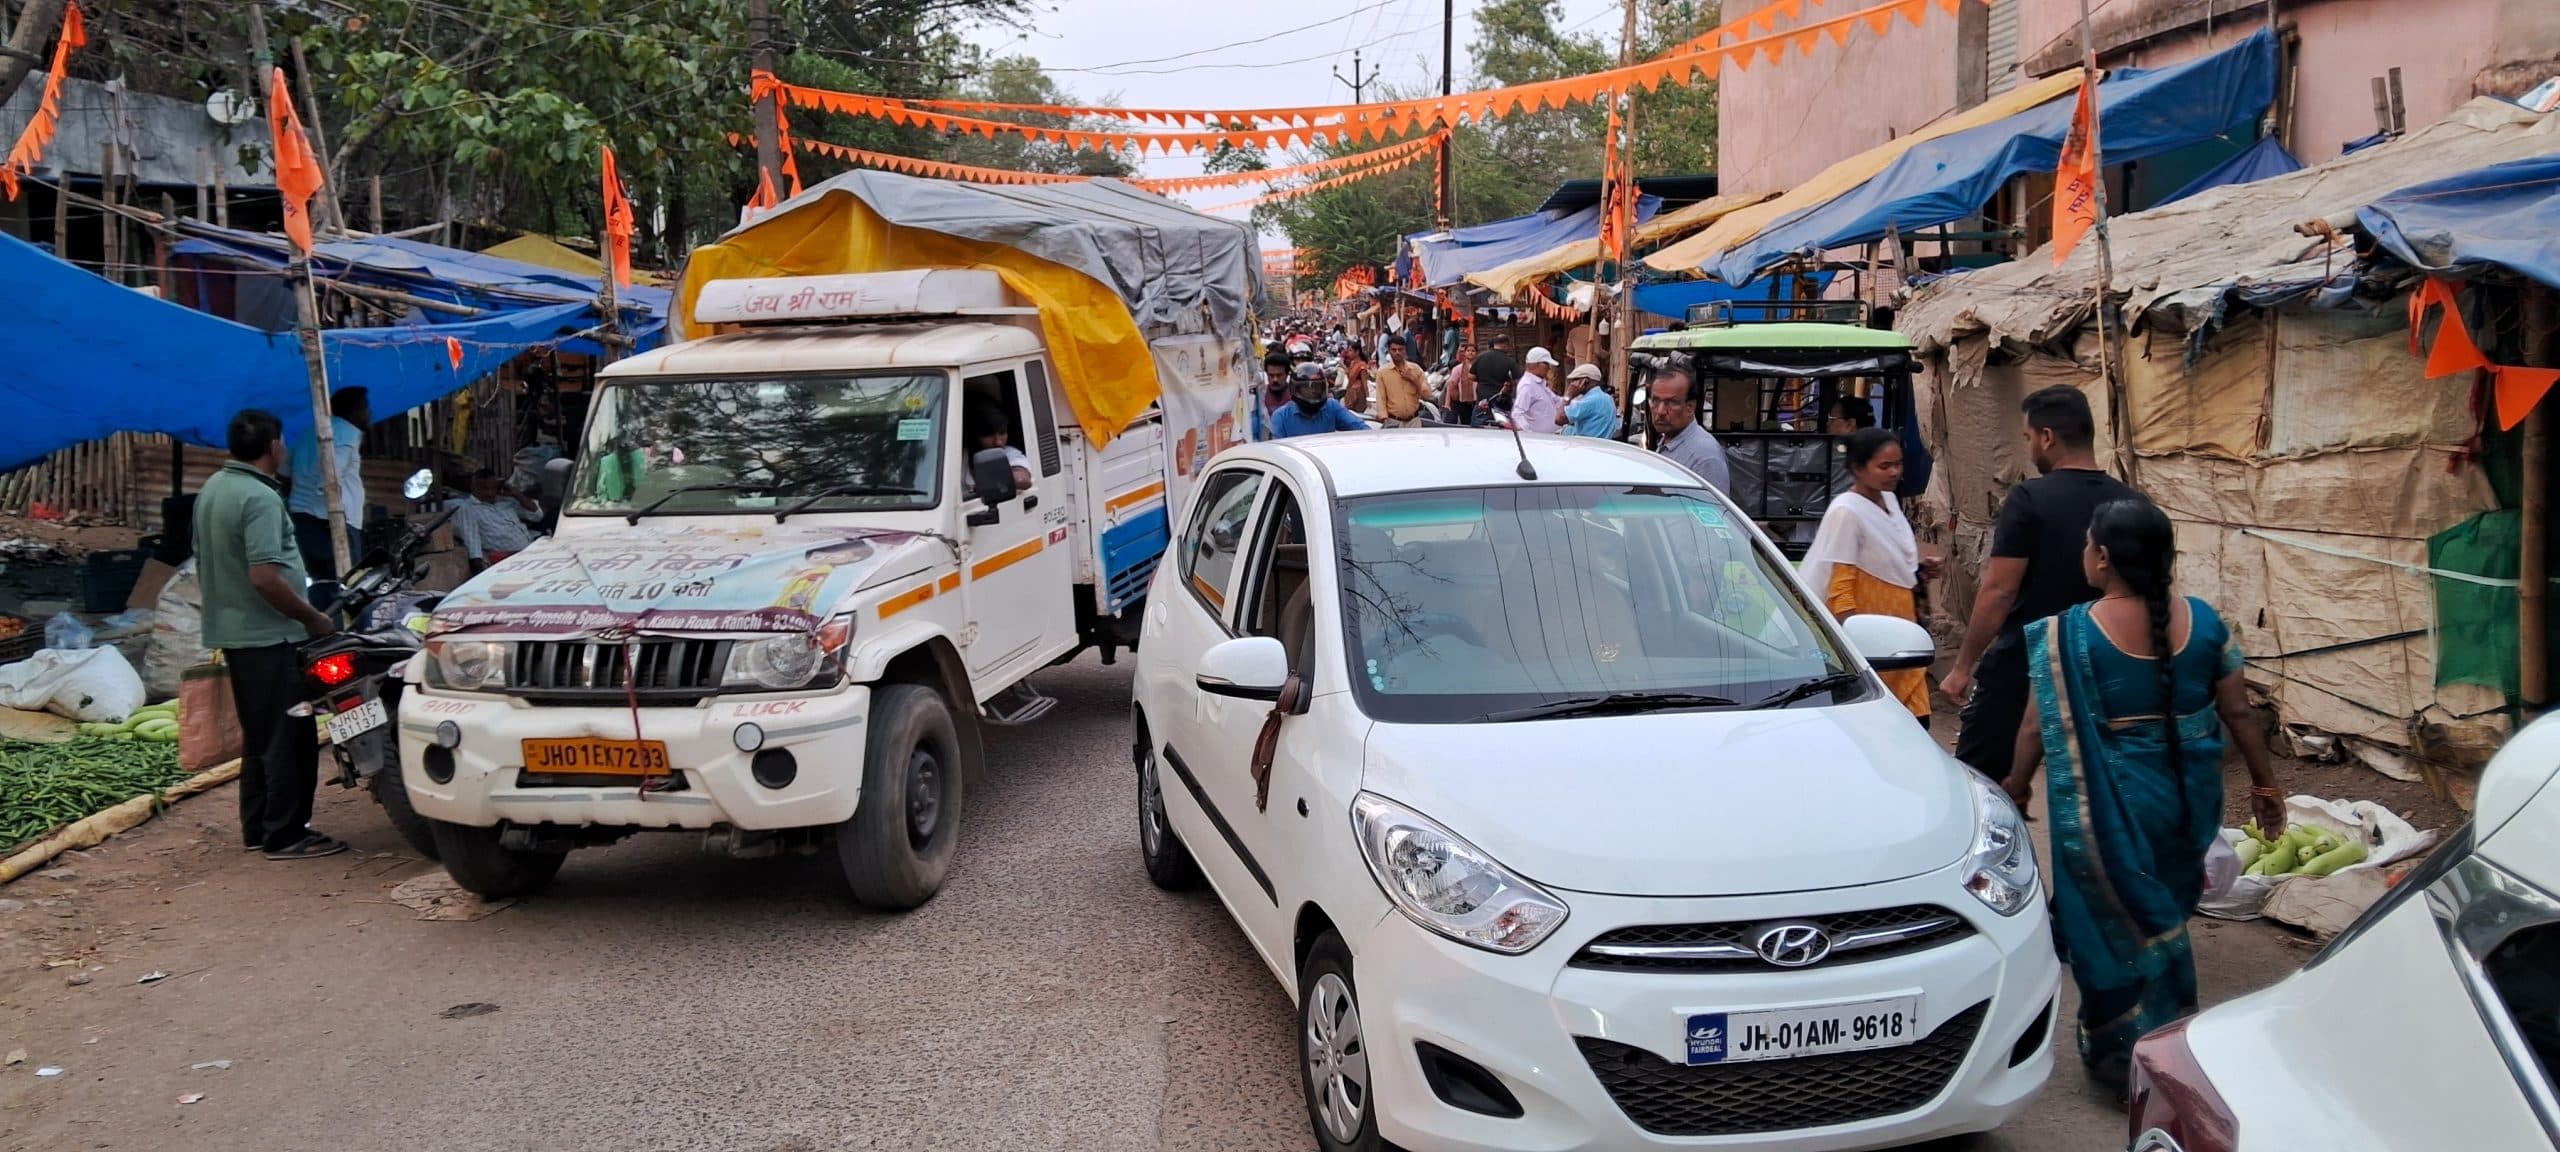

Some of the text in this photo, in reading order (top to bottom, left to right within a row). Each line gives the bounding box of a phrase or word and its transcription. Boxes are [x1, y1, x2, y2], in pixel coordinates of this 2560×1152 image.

[745, 286, 857, 313] जय श्री राम
[587, 553, 642, 571] की
[629, 582, 667, 600] 10
[529, 609, 577, 627] Opposite
[649, 614, 684, 629] Kanke
[720, 613, 763, 630] Ranchi
[733, 700, 808, 717] LUCK
[1853, 1012, 1903, 1042] 9618
[1690, 1038, 1722, 1047] HYUNDAI
